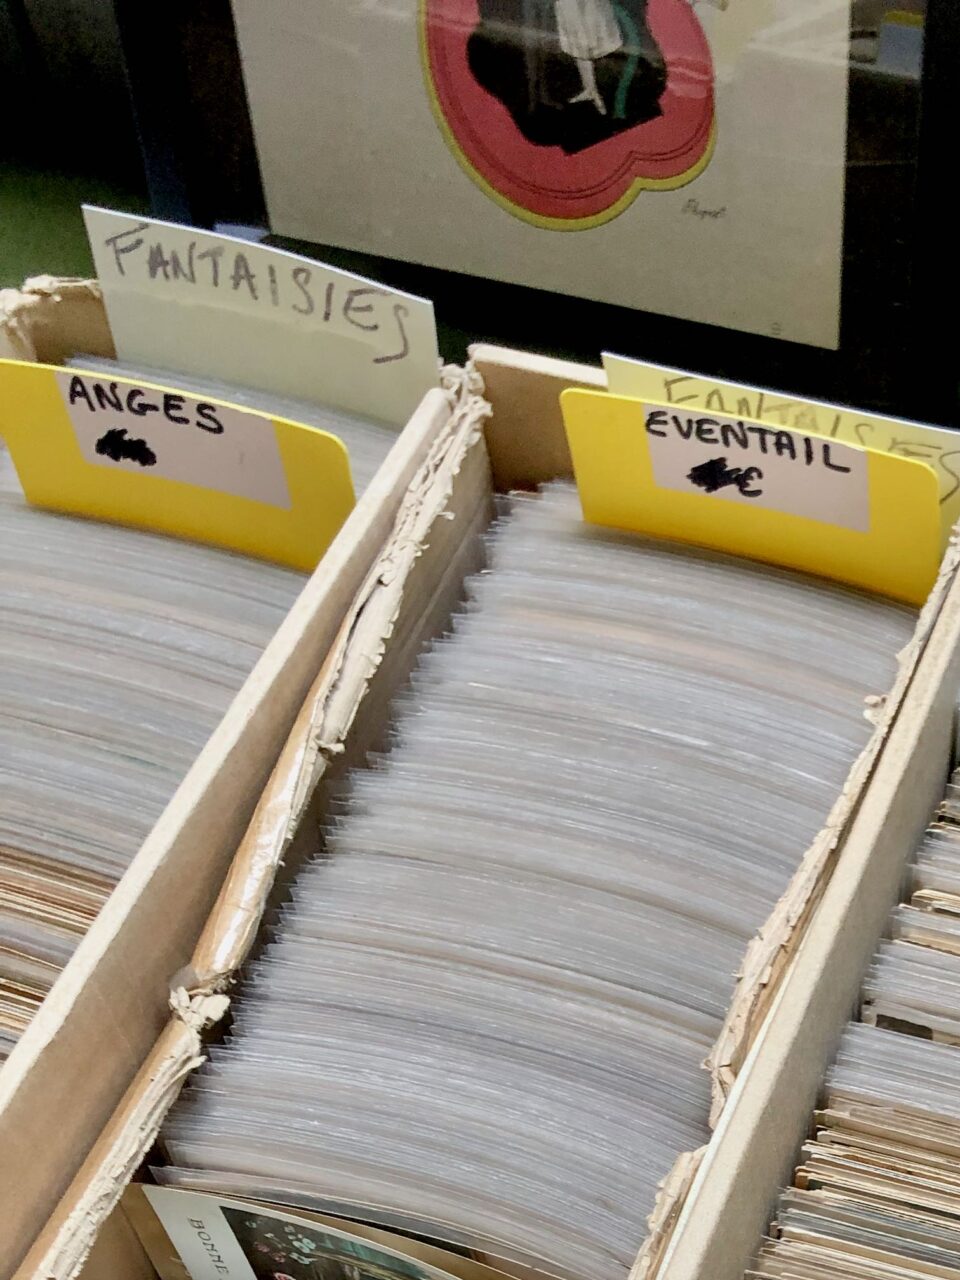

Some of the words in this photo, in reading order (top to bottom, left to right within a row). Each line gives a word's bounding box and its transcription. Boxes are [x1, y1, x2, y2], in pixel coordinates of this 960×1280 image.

[105, 223, 410, 363] FANTAISIES
[69, 375, 225, 436] ANGES
[645, 411, 851, 474] EVENTAIL
